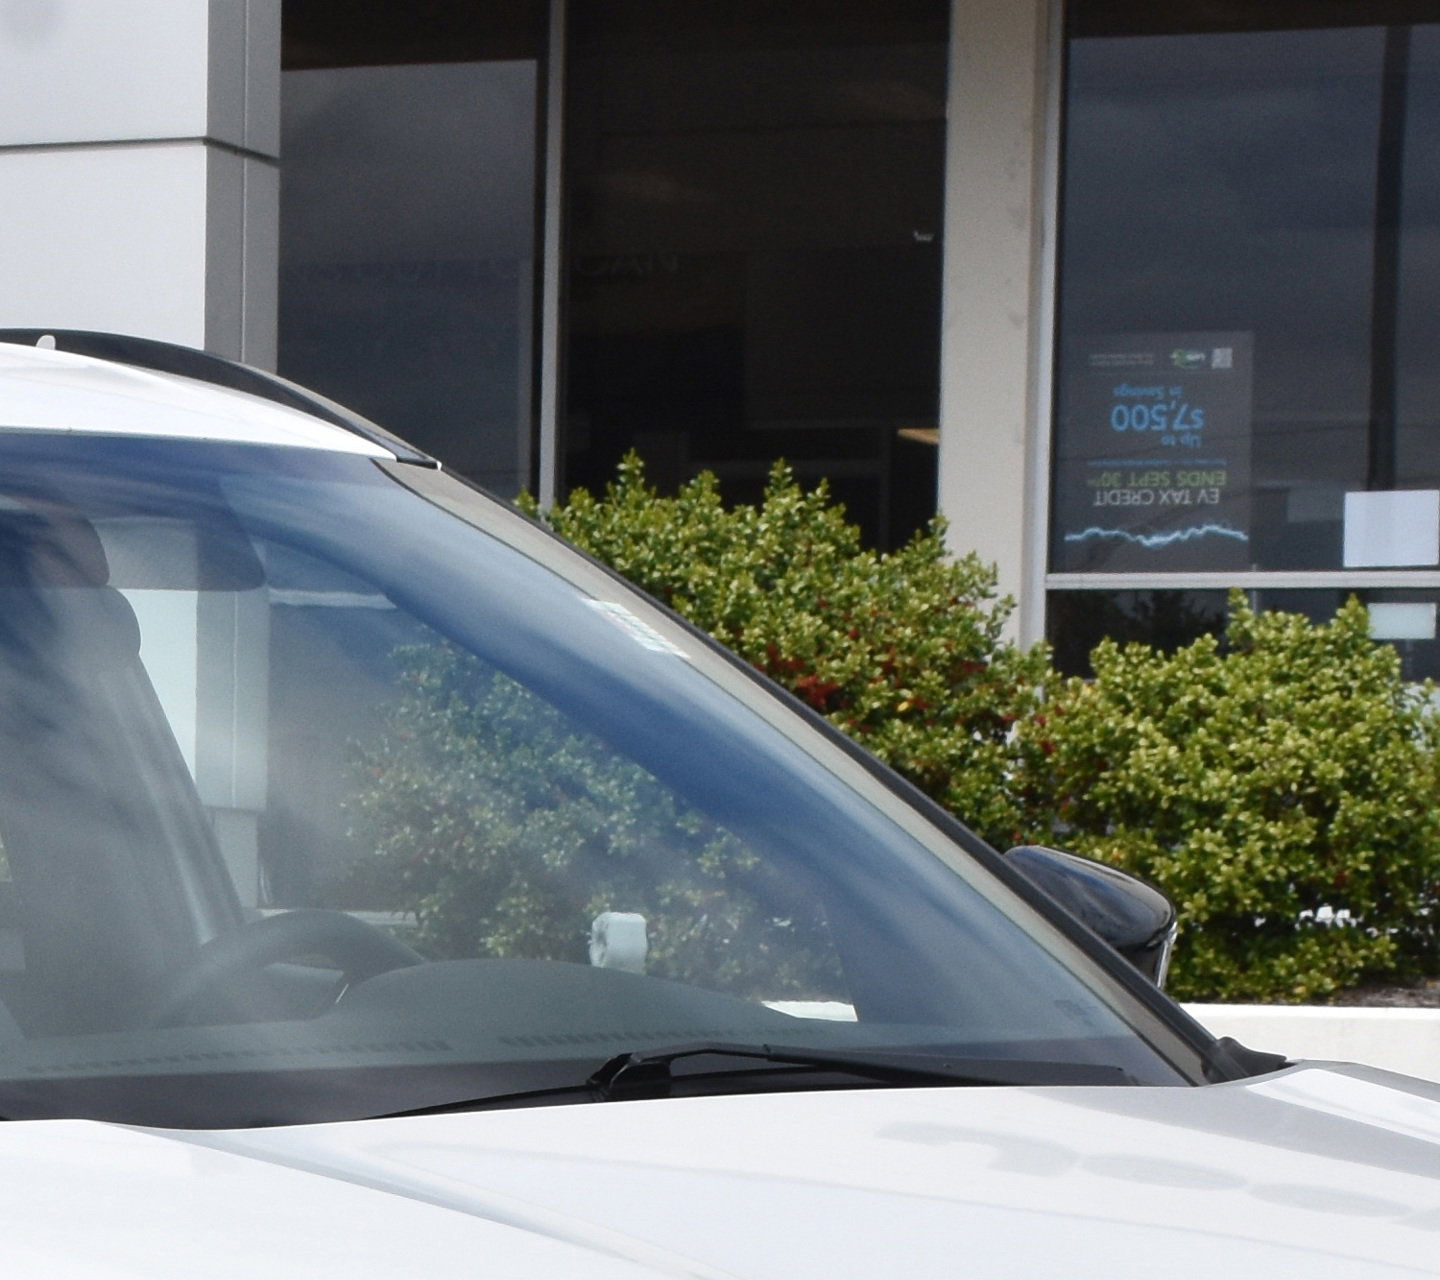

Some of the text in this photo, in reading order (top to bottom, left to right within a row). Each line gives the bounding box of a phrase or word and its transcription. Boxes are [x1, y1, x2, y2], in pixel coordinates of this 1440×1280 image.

[1110, 400, 1206, 432] $7,500
[1129, 471, 1170, 487] SEPT
[1177, 470, 1227, 486] ENDS
[1093, 488, 1220, 506] EV TAX CREDIT
